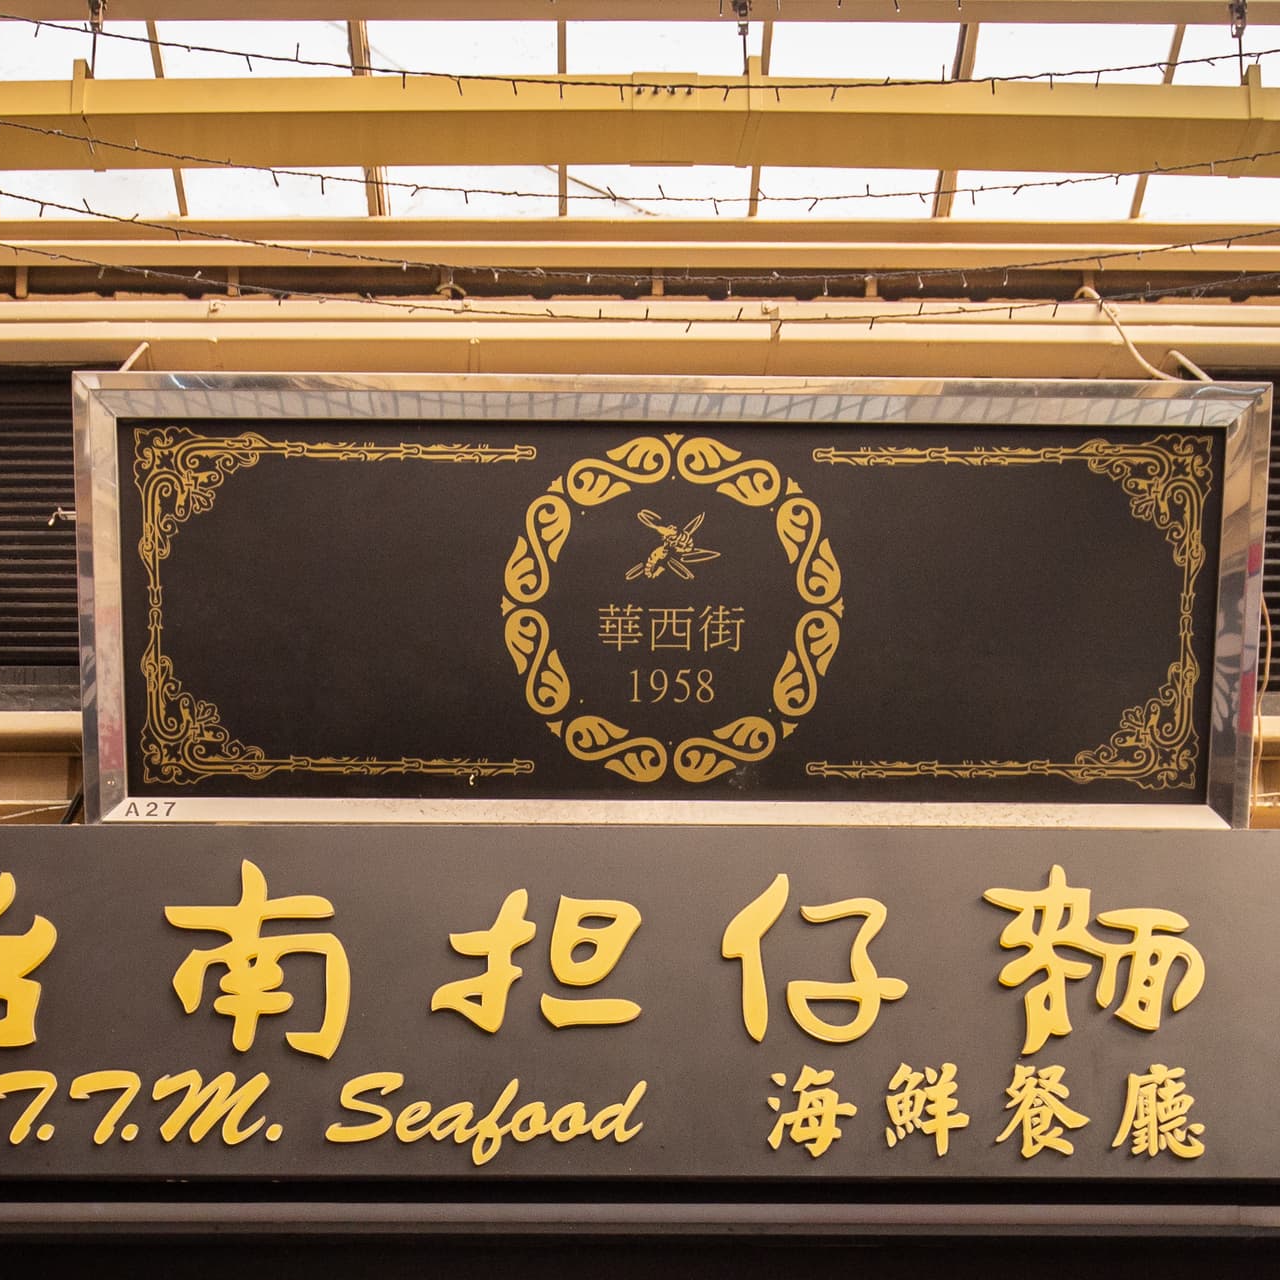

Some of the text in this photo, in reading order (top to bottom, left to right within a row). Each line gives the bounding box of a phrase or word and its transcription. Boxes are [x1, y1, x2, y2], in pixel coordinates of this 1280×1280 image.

[597, 603, 746, 653] 華西街
[626, 667, 716, 705] 1958
[125, 801, 177, 817] A27
[325, 1070, 648, 1167] Seafood
[766, 1062, 1207, 1159] 海鮮餐廳
